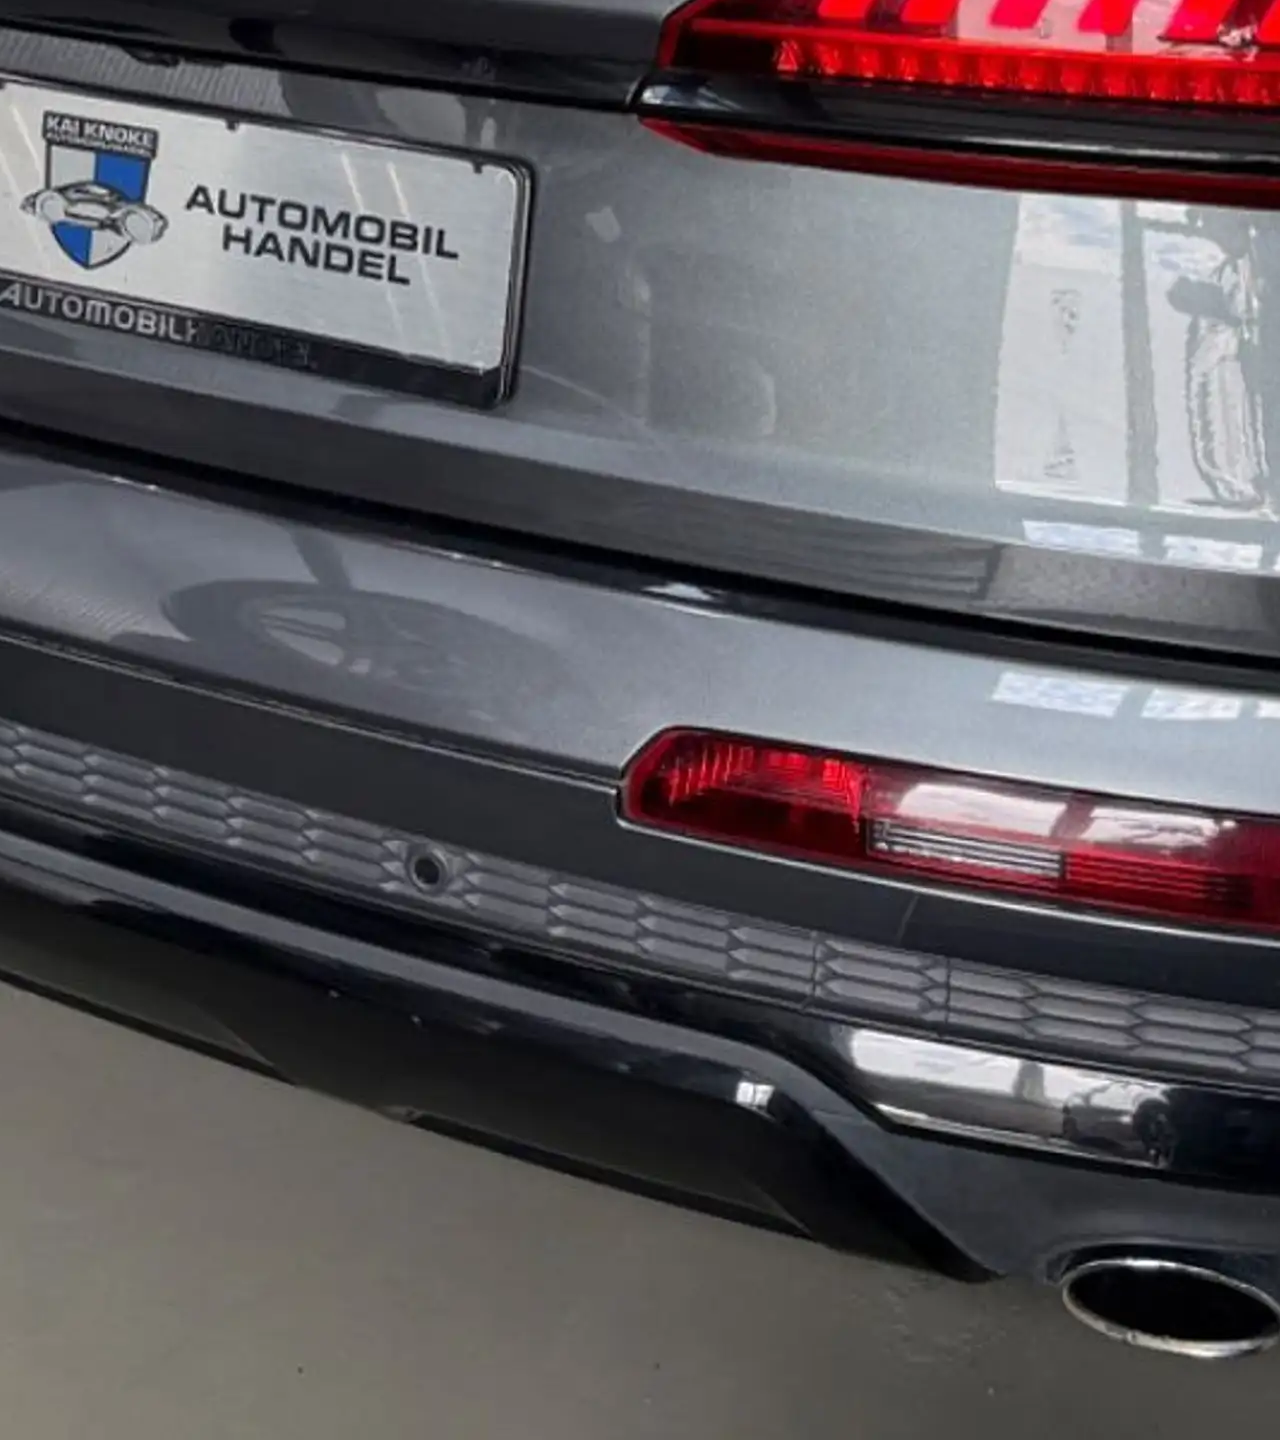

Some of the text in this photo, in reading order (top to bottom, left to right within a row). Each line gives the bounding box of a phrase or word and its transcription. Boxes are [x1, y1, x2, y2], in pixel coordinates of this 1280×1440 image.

[46, 115, 81, 135] KAI
[83, 121, 154, 148] KNOKE
[185, 184, 459, 260] AUTOMOBIL
[222, 223, 411, 286] HANDEL
